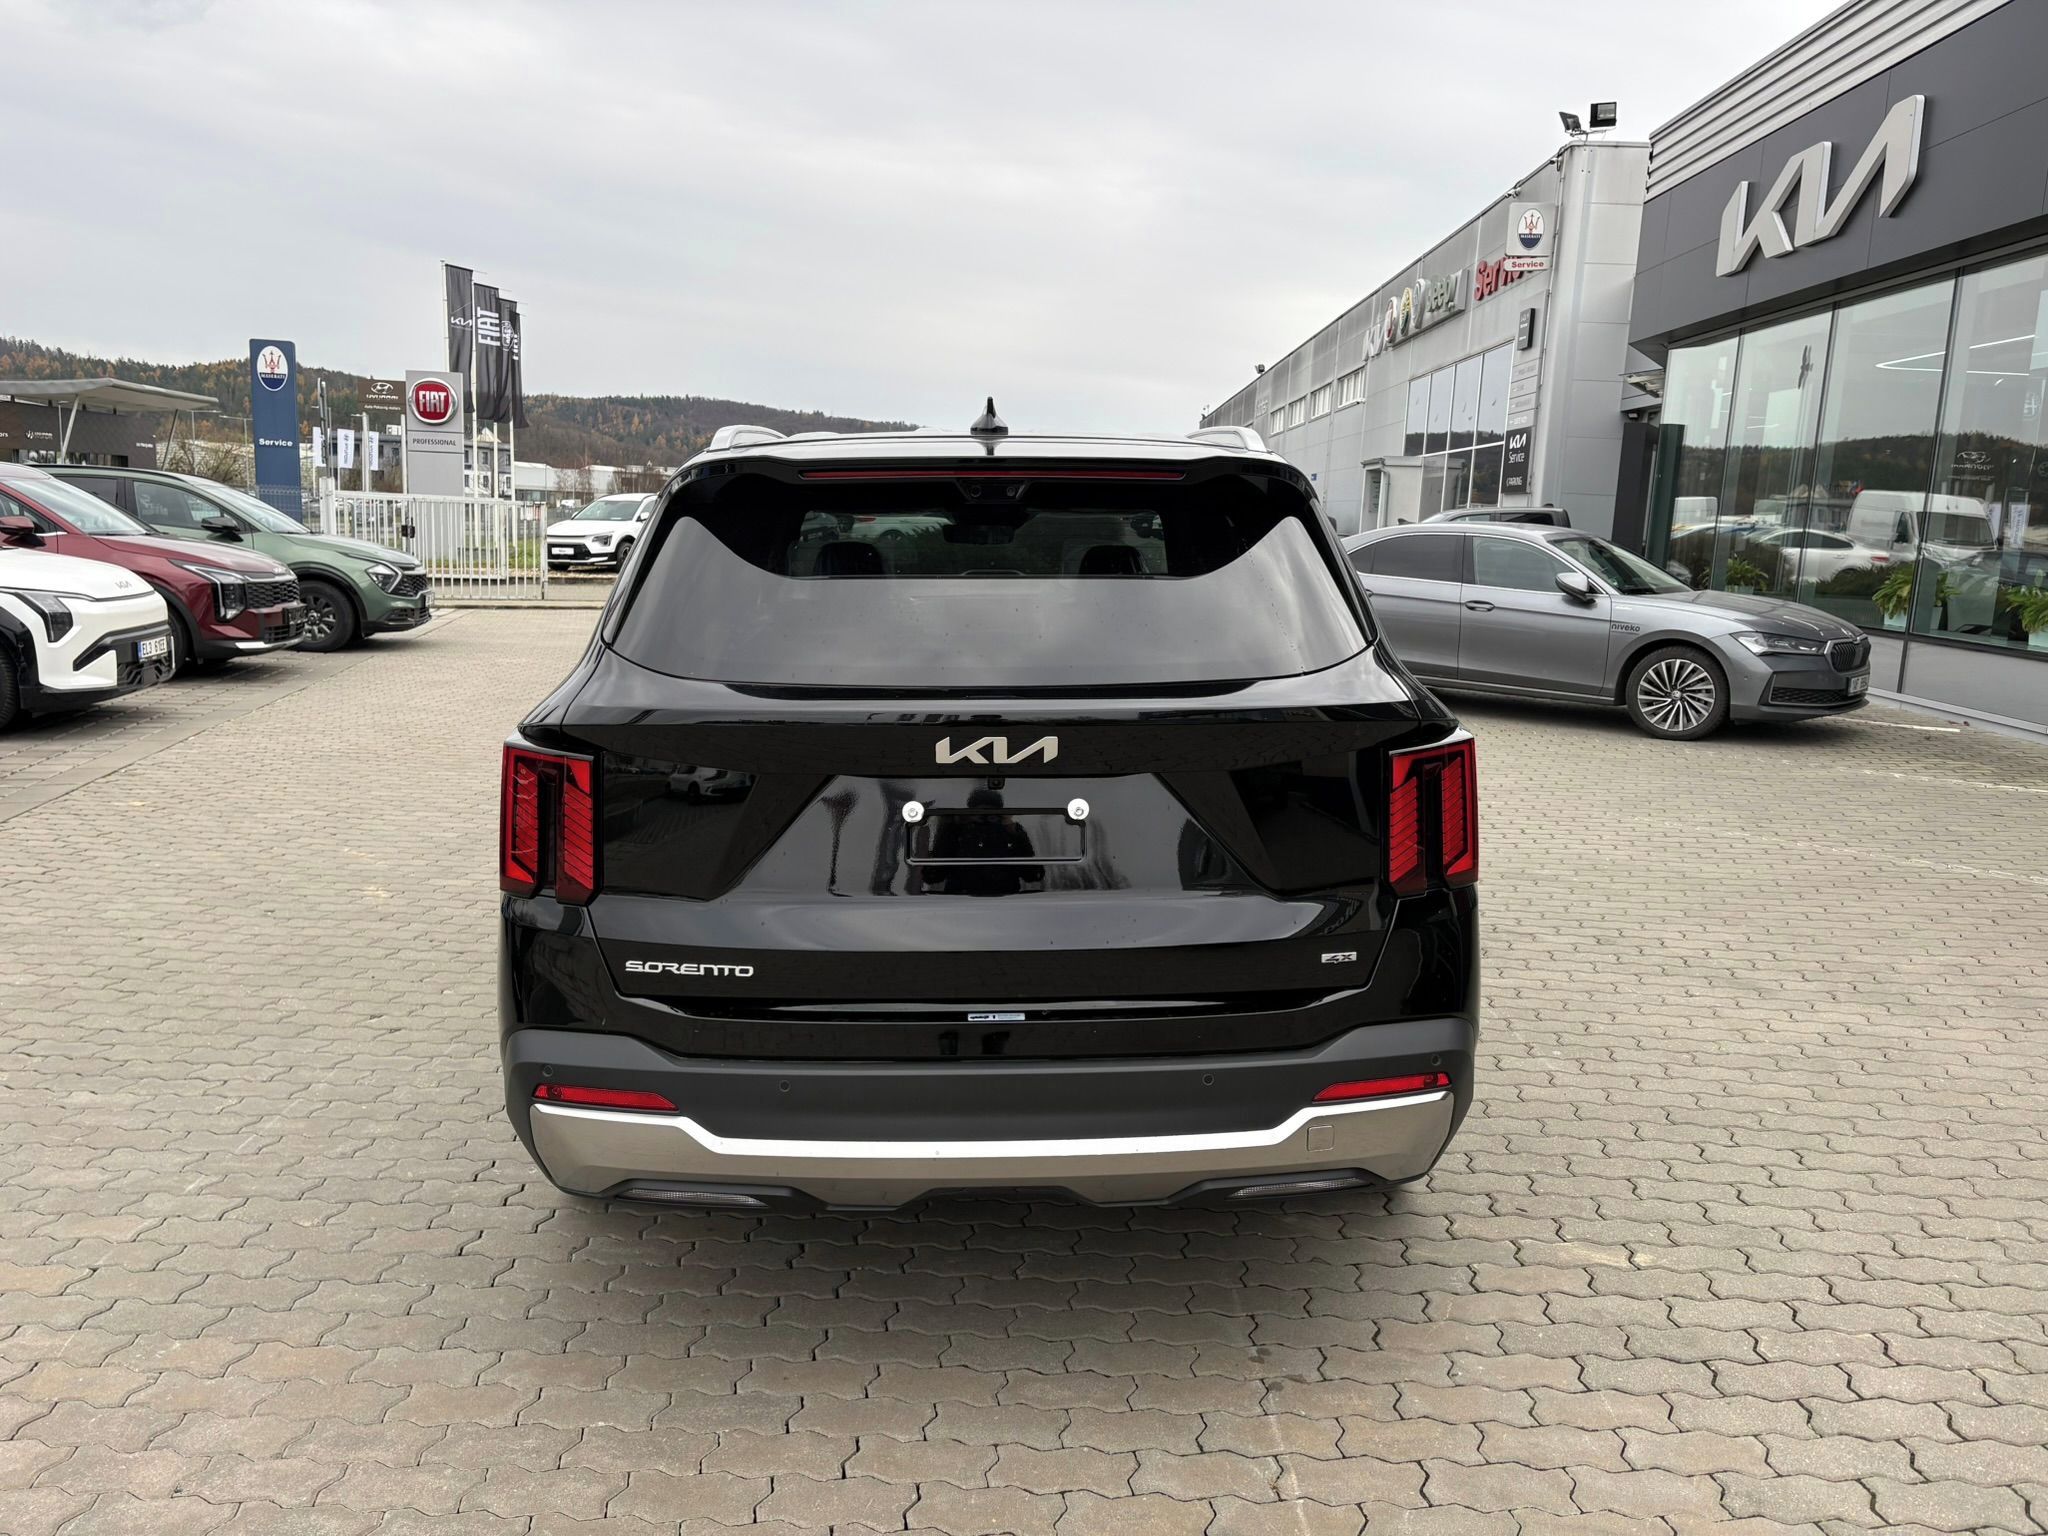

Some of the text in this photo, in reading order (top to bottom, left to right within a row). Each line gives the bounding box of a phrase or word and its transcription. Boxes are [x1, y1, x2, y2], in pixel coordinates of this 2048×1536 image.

[1715, 94, 1926, 277] KIA
[1511, 260, 1544, 268] Service
[476, 306, 500, 346] FIAT
[418, 390, 447, 412] FIAT
[258, 438, 293, 447] Service
[412, 438, 456, 446] PROFESSIONAL
[1509, 433, 1527, 449] KIA
[1508, 451, 1525, 463] Service
[1611, 623, 1641, 632] niveko
[935, 736, 1059, 763] KIA
[625, 960, 753, 977] SORENTO
